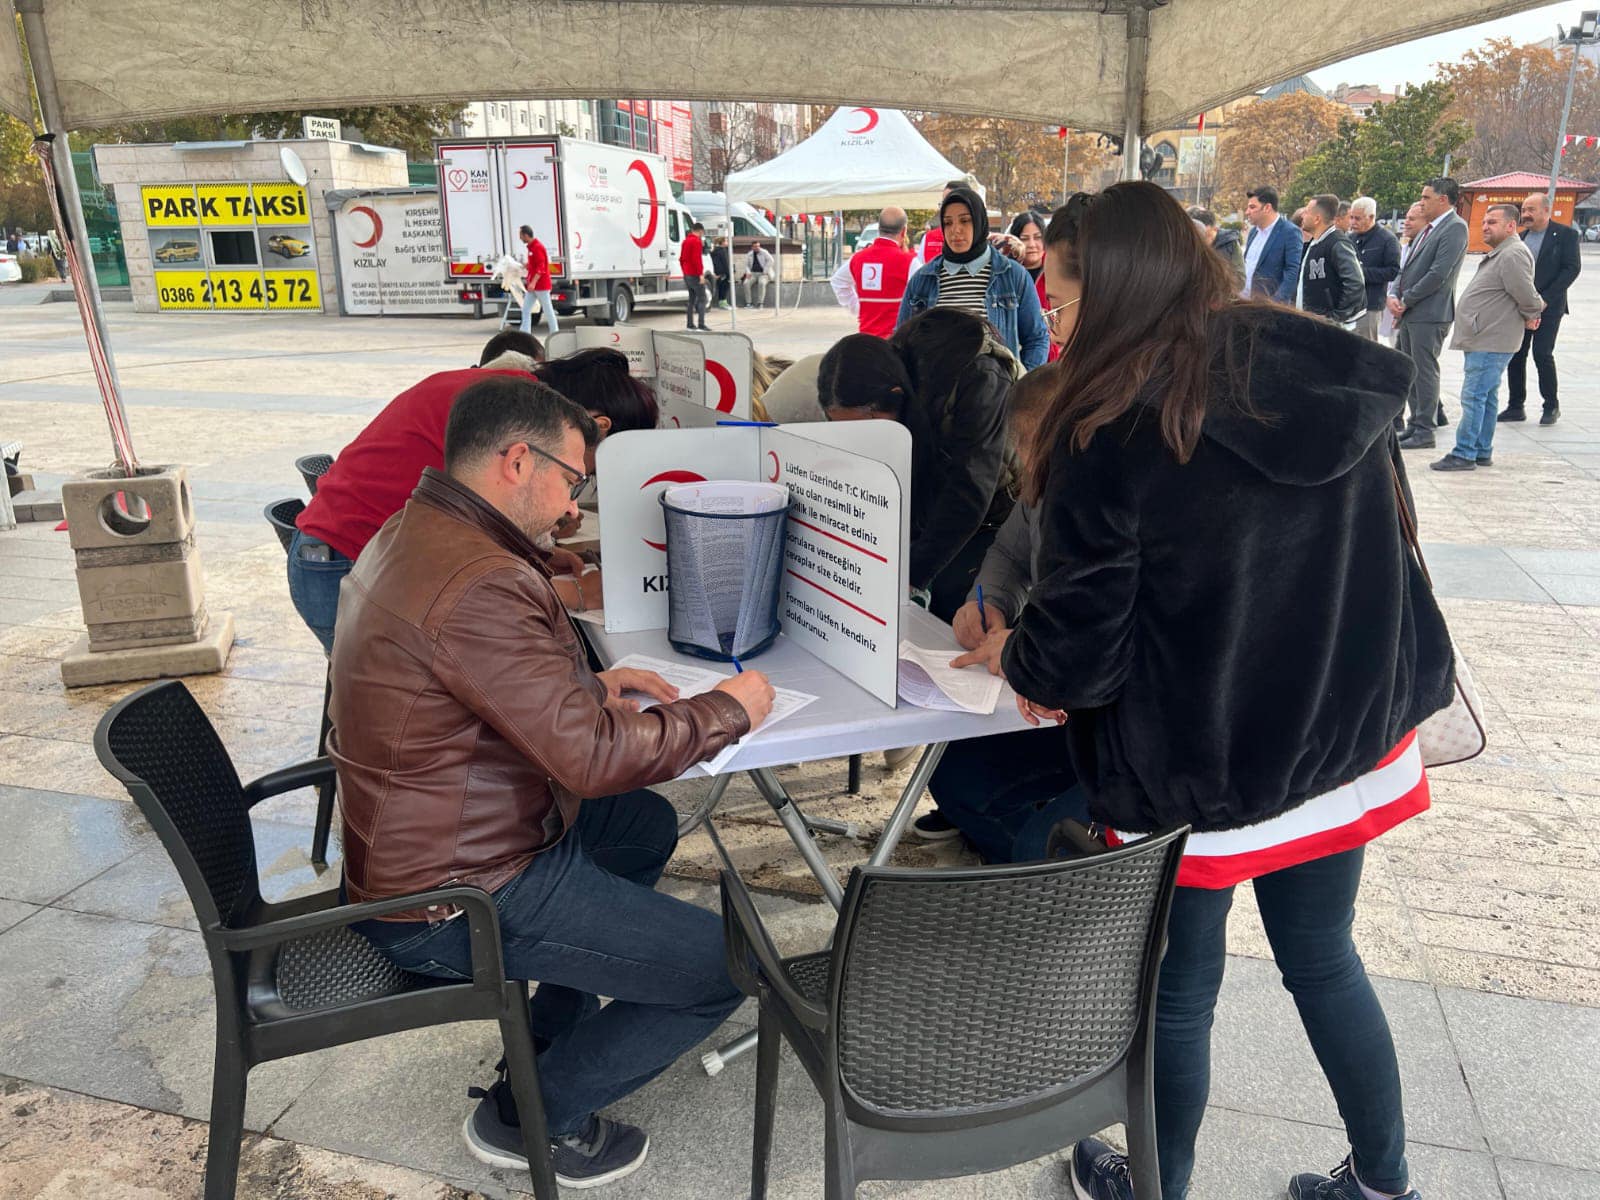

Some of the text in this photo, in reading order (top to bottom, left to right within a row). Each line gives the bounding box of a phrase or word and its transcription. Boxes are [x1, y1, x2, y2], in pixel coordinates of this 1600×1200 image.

[312, 120, 335, 129] PARK
[471, 170, 488, 178] KAN
[148, 190, 306, 218] PARK TAKSİ
[405, 208, 439, 217] KIRŞEHİR
[402, 229, 443, 239] BAŞKANLIĞ
[413, 219, 442, 228] MERKEZ
[353, 258, 387, 268] KIZILAY
[1309, 257, 1326, 280] M
[161, 278, 312, 303] 0386 213 45 72
[785, 462, 808, 478] Lütfen
[809, 471, 843, 492] üzerinde
[860, 488, 889, 509] Kimlik
[806, 489, 822, 501] olan
[824, 497, 851, 515] resimli
[853, 506, 866, 520] bir
[808, 509, 818, 519] ile
[819, 514, 849, 533] miracat
[851, 527, 878, 546] ediniz
[786, 549, 862, 596] cevaplar size özeldir.
[817, 546, 862, 575] vereceğiniz
[786, 591, 877, 653] Formları lütfen kendiniz
[786, 608, 829, 642] doldurunuz.
